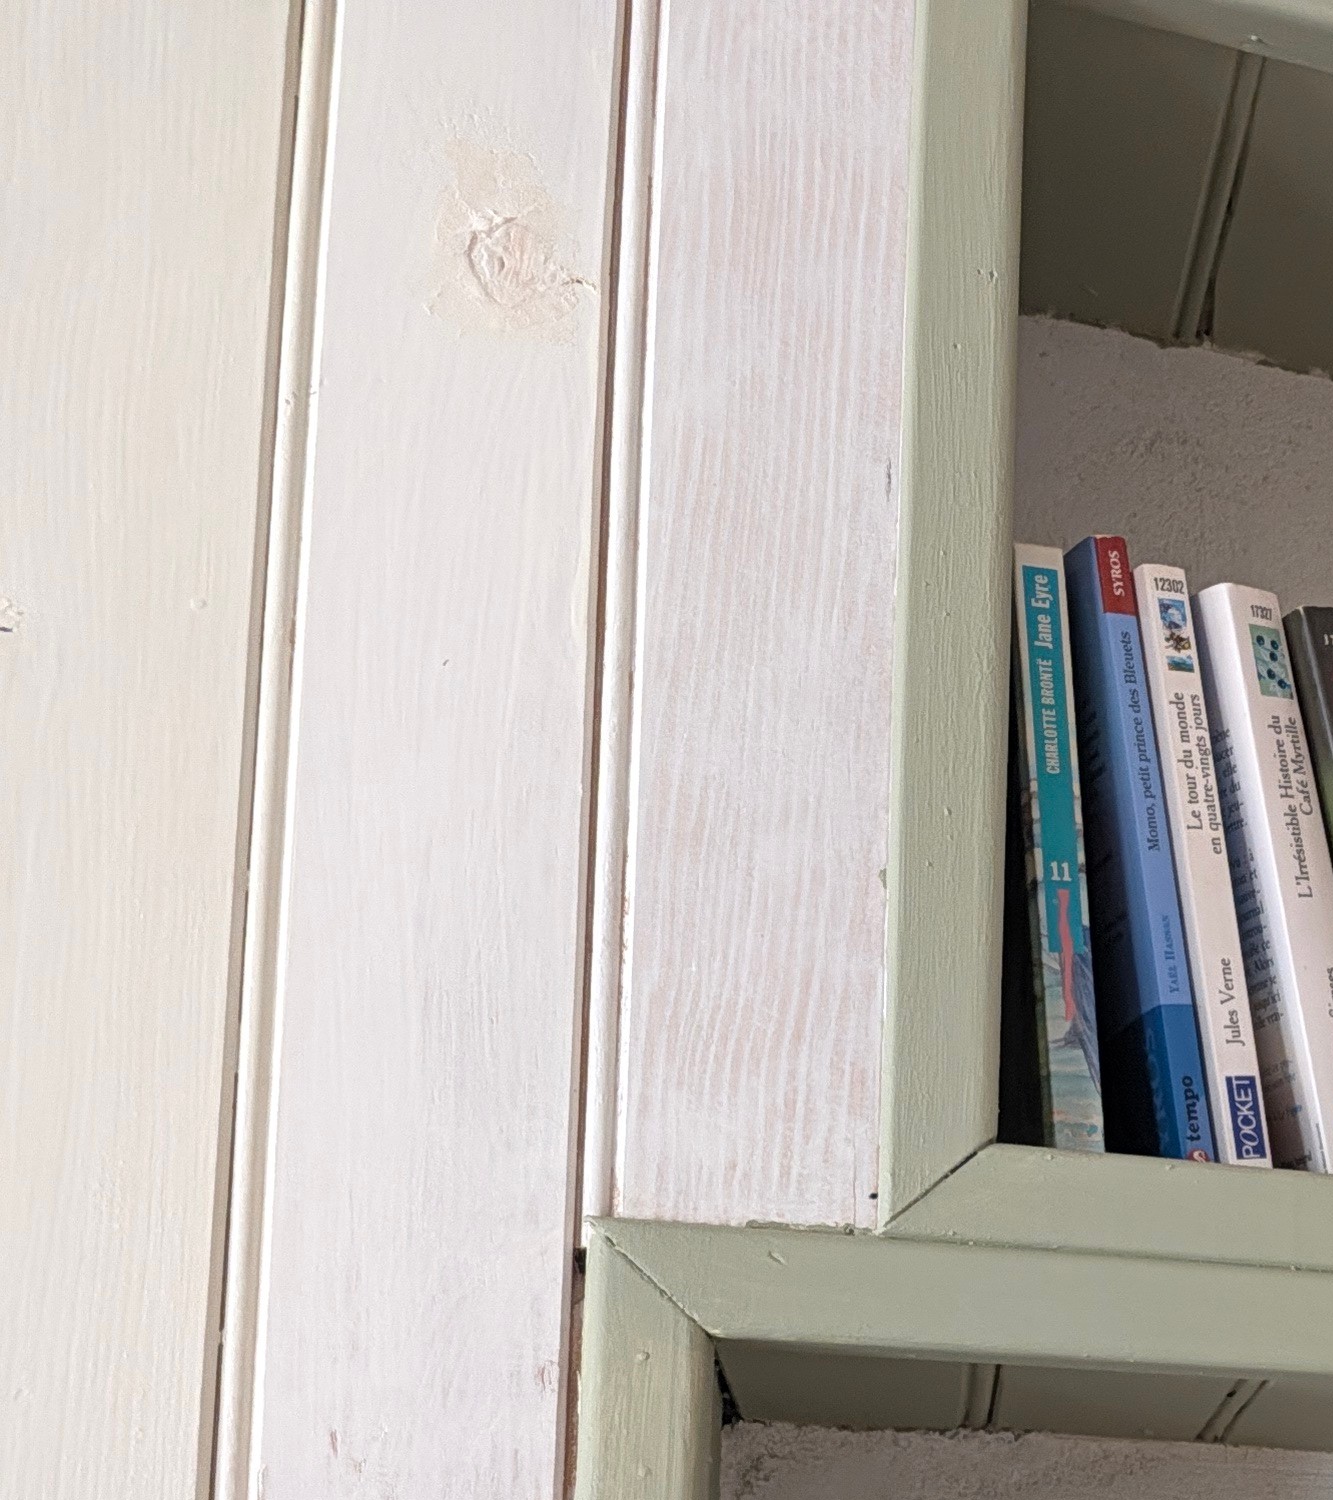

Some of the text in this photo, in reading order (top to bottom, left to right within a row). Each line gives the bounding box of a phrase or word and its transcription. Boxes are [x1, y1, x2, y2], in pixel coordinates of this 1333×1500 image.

[1031, 574, 1054, 649] Jane Eyre
[1108, 550, 1125, 597] SYROS
[1154, 577, 1185, 593] 12302
[1042, 710, 1060, 774] CHARLOTTE
[1120, 631, 1160, 851] Momo, petit prince des Bleuets
[1169, 691, 1203, 830] Le tour du monde
[1190, 693, 1222, 854] en quatre-vingts jours
[1285, 716, 1312, 816] Café Myrtille
[1268, 715, 1312, 898] L'Irrésistible Histoire du
[1050, 861, 1072, 881] 11
[1218, 958, 1246, 1046] Jules Verne
[1182, 1076, 1200, 1142] tempo
[1234, 1076, 1260, 1159] POCKET
